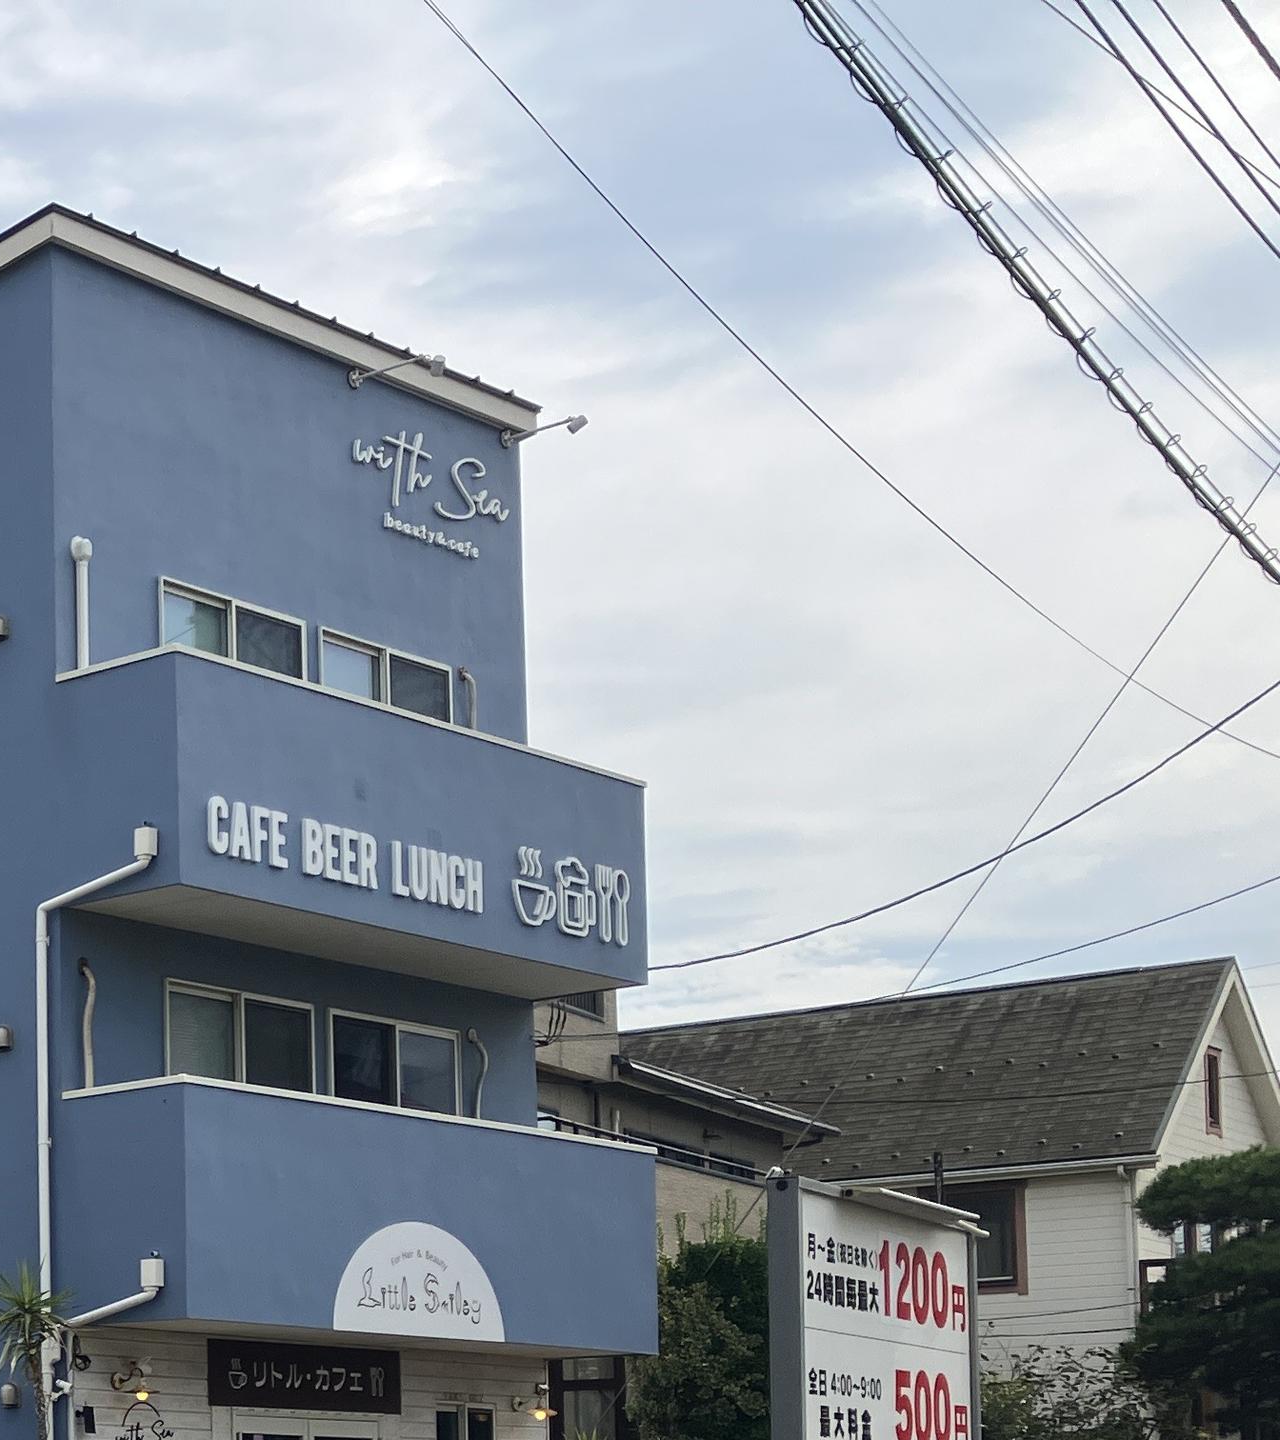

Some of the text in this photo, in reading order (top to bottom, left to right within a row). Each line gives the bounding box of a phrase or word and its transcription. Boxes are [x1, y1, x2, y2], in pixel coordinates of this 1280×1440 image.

[352, 430, 510, 522] with Sea
[207, 795, 484, 915] CAFE BEER LUNCH
[253, 1361, 363, 1393] リトル・カフェ
